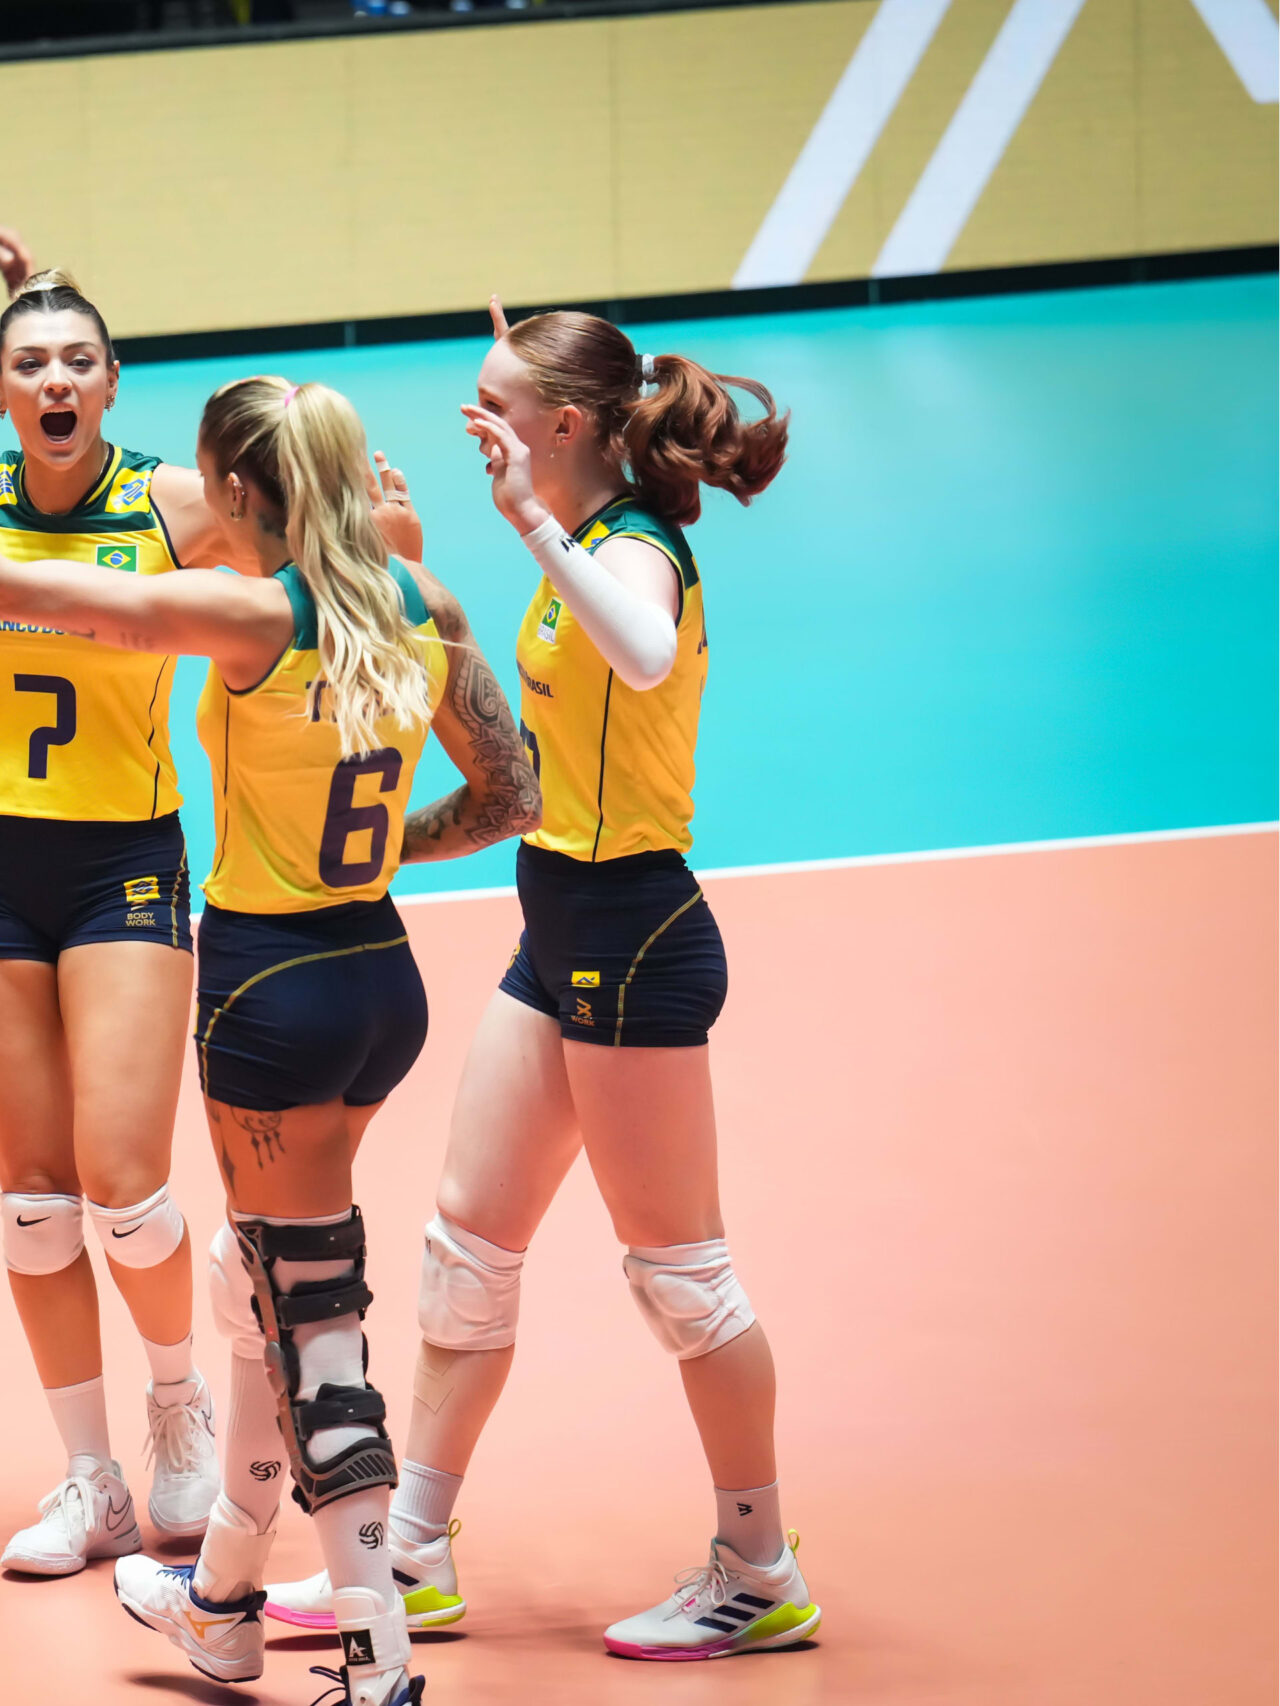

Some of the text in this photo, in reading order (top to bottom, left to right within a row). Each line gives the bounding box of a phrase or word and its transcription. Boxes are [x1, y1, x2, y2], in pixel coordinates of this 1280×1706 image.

[13, 673, 77, 779] 7
[319, 747, 403, 888] 6
[125, 919, 156, 927] WORK
[127, 912, 154, 920] BODY
